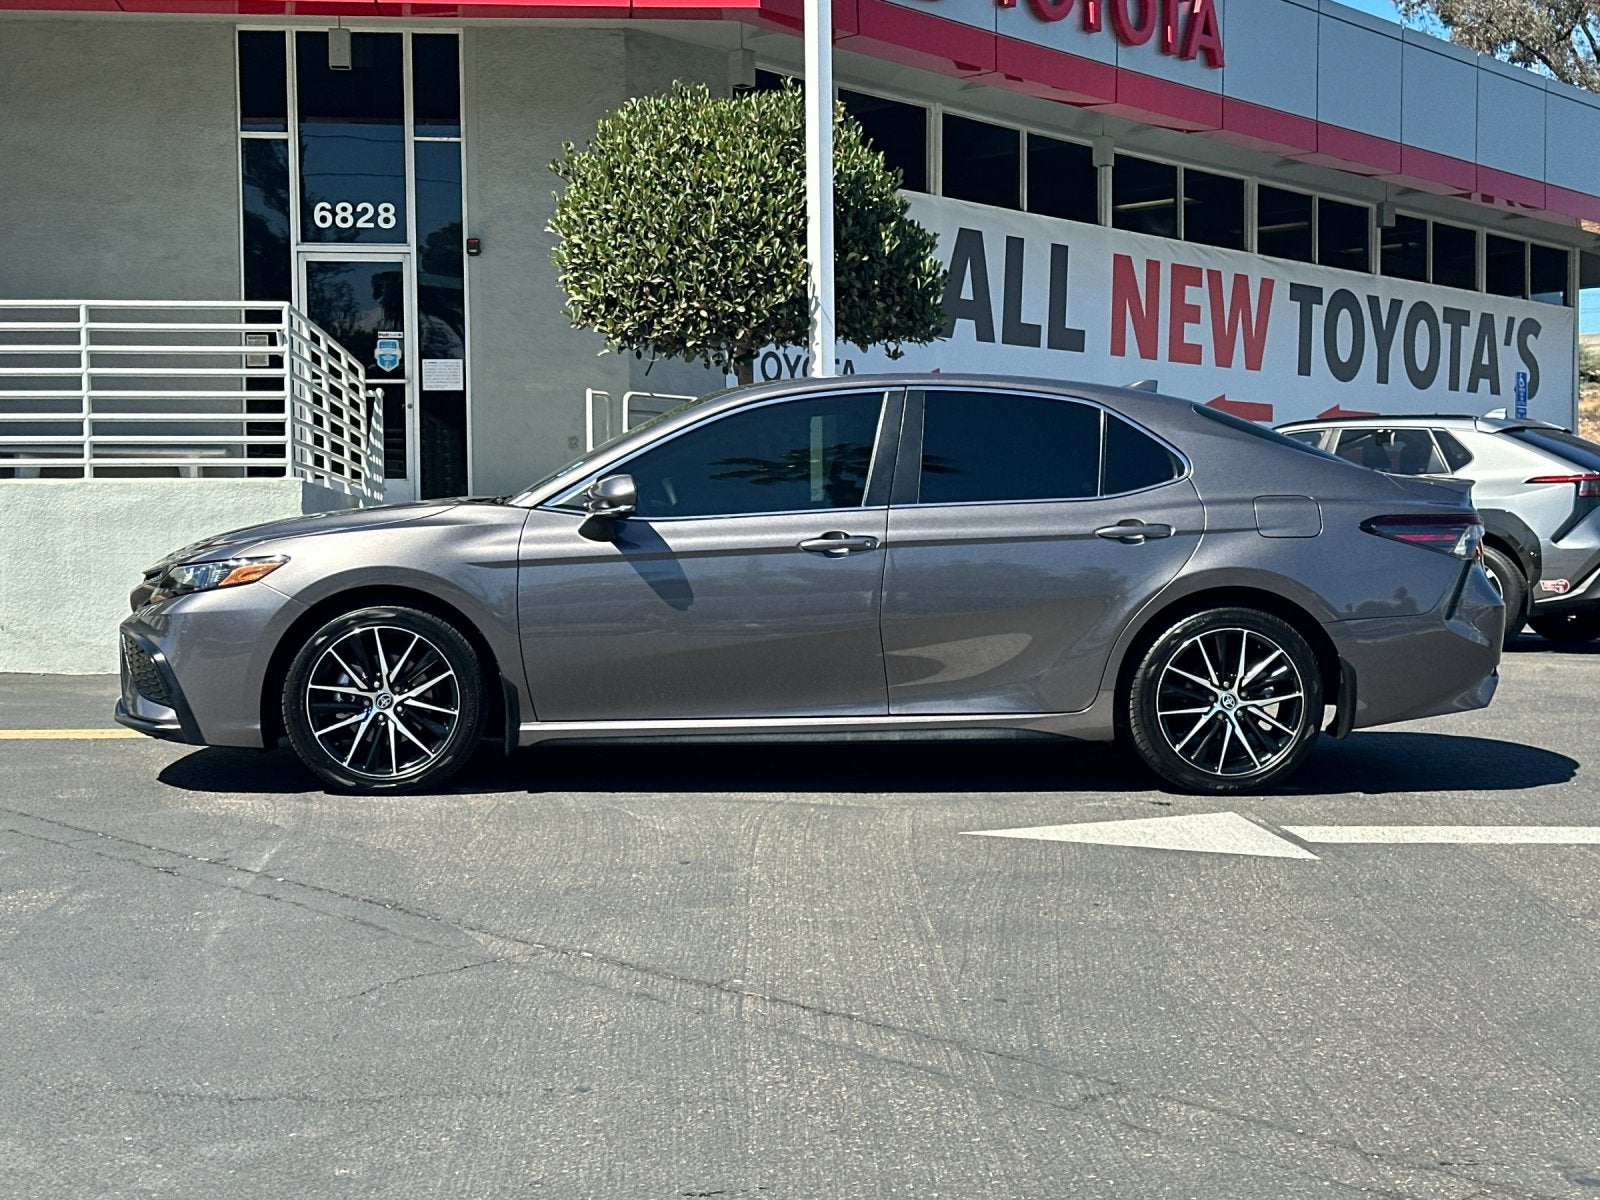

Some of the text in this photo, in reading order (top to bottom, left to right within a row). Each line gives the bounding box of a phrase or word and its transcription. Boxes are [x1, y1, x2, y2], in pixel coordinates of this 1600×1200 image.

[998, 0, 1225, 68] OTA
[313, 201, 396, 229] 6828
[942, 227, 1541, 401] ALL NEW TOYOTA'S
